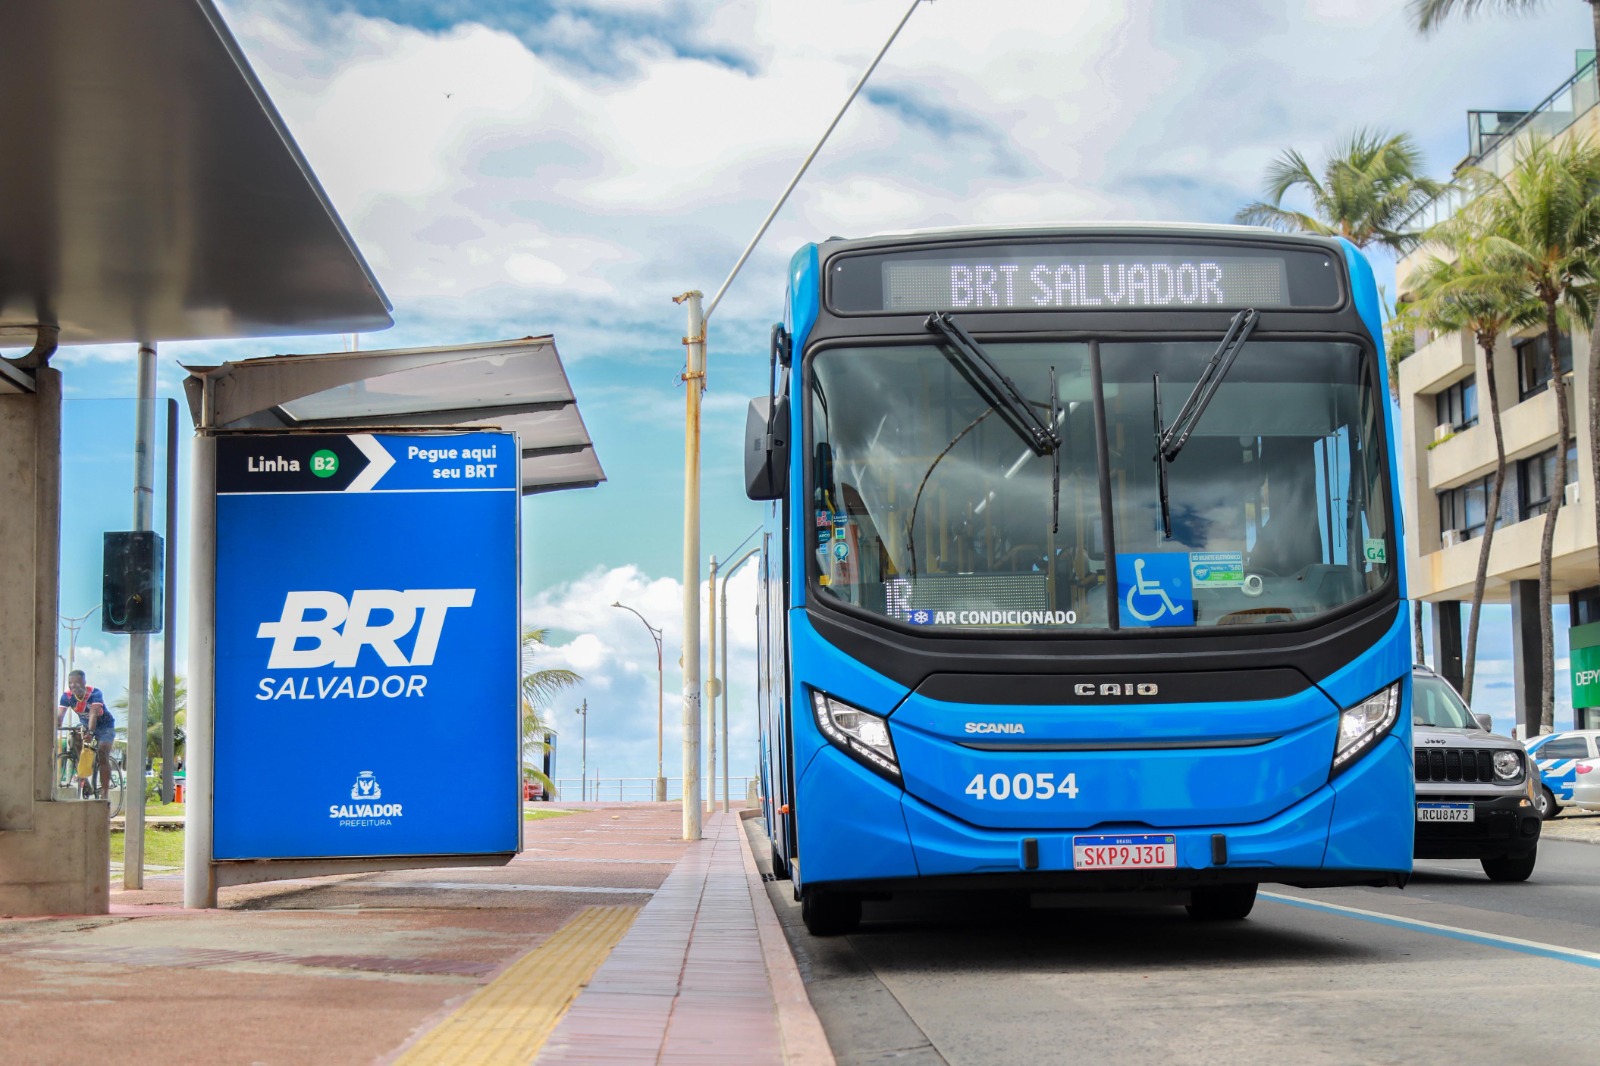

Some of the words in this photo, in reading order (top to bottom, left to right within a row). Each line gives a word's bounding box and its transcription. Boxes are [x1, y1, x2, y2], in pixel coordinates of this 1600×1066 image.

[950, 264, 1018, 307] BRT
[1030, 262, 1224, 307] SALVADOR
[407, 446, 457, 463] Pegue
[461, 444, 497, 461] aqui
[248, 456, 300, 473] Linha
[314, 457, 335, 471] B2
[432, 468, 461, 479] seu
[465, 464, 498, 479] BRT
[1366, 547, 1385, 561] G4
[934, 612, 956, 625] AR
[959, 610, 1077, 625] CONDICIONADO
[256, 588, 476, 669] BRT
[1575, 669, 1600, 686] DEPY
[255, 674, 428, 701] SALVADOR
[1074, 683, 1159, 696] CAIO
[965, 722, 1025, 734] SCANIA
[965, 772, 1079, 800] 40054
[329, 804, 403, 818] SALVADOR
[1422, 809, 1468, 820] RCU8A73
[339, 819, 392, 827] PREFEITURA
[1084, 846, 1165, 866] SKP9J30
